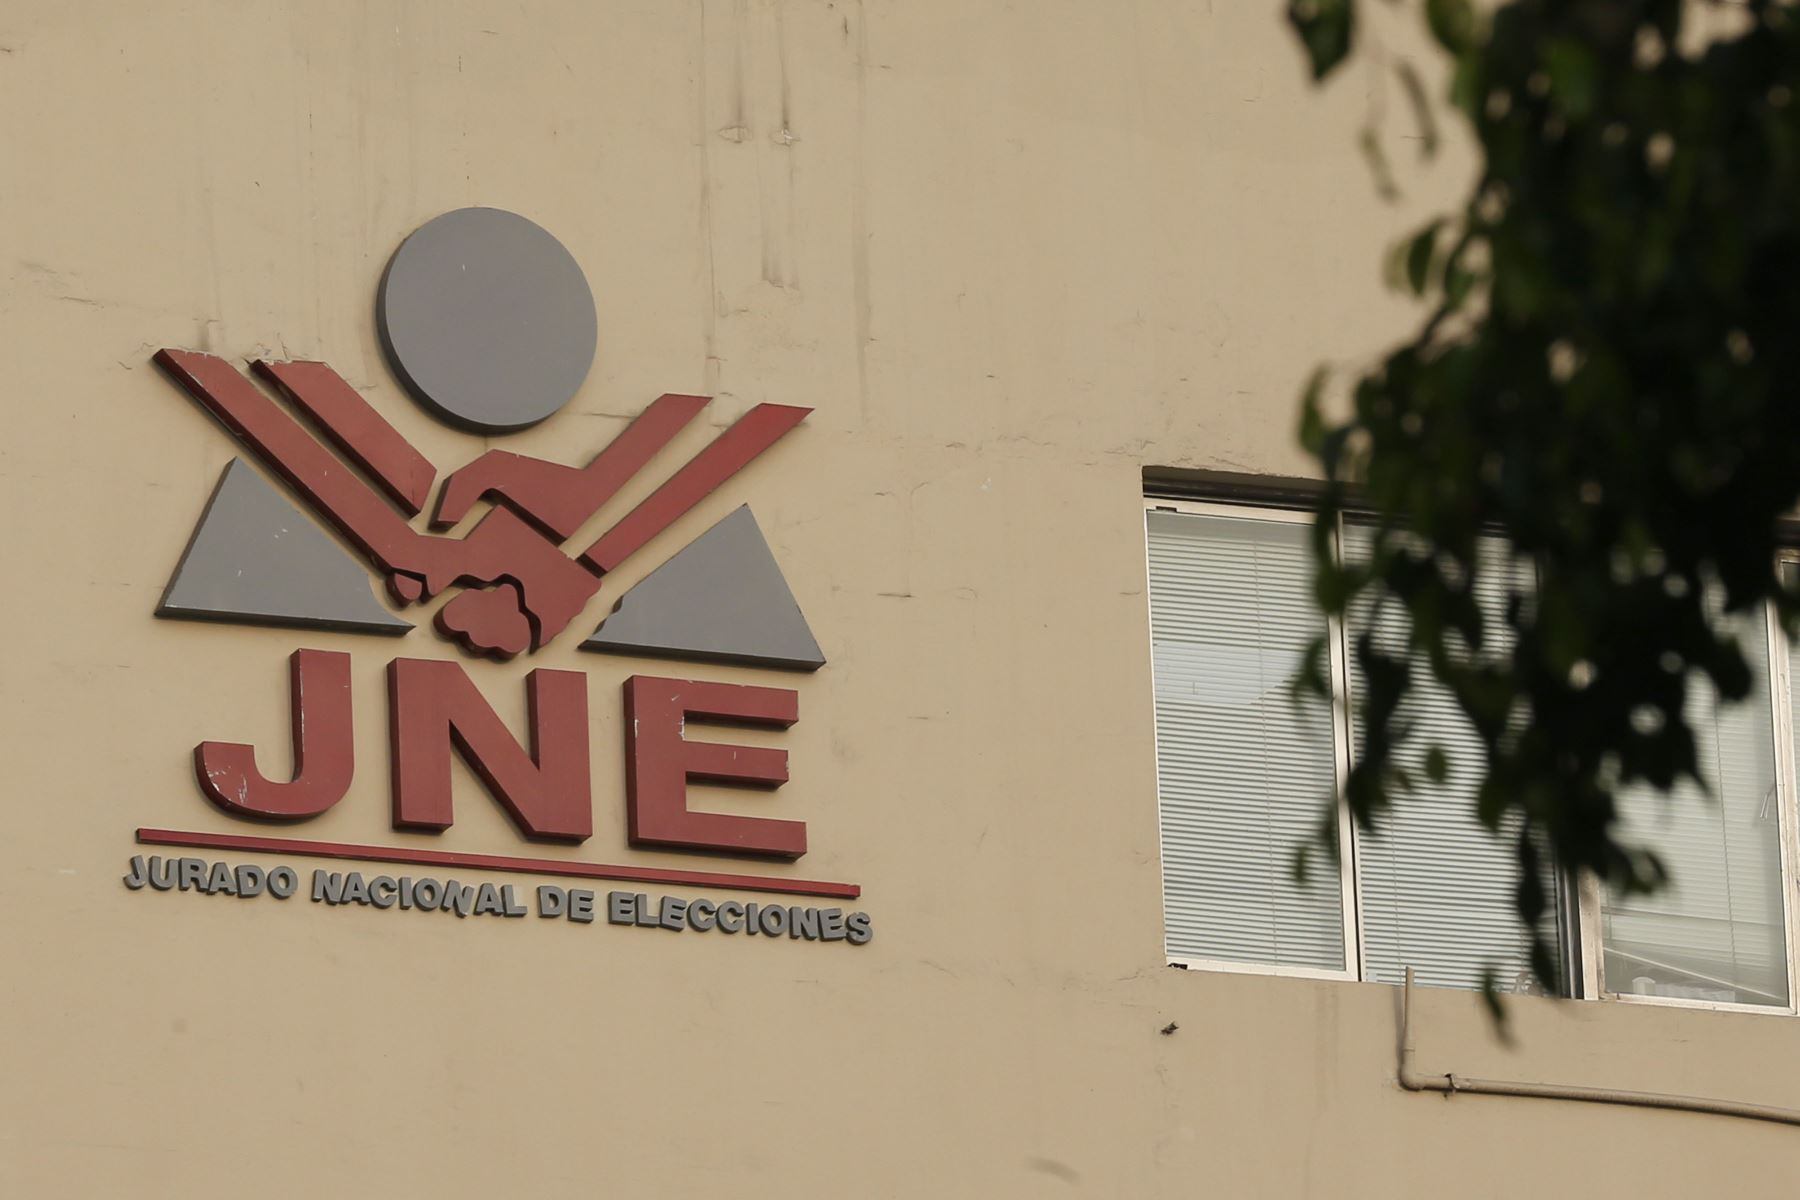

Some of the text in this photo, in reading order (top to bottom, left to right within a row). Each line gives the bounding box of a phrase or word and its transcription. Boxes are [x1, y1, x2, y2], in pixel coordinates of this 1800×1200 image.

[194, 648, 807, 863] JNE
[124, 855, 873, 945] JURADO NACIONAL DE ELECCIONES
